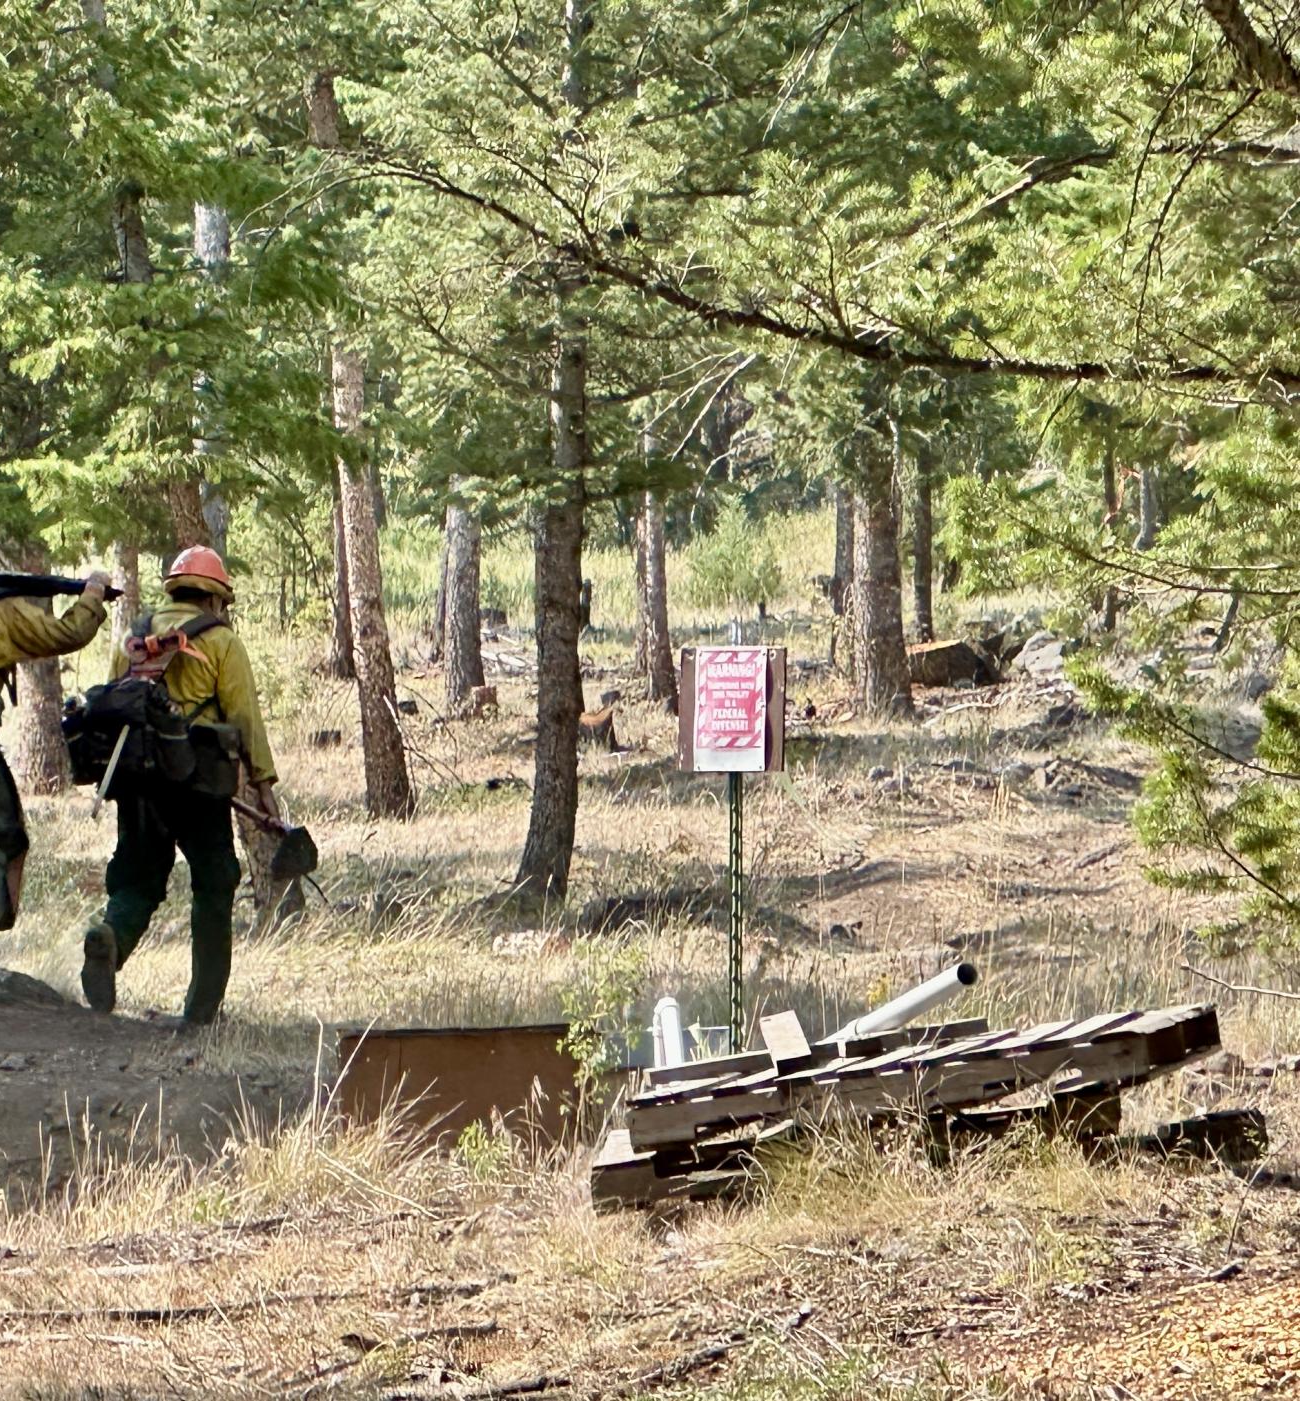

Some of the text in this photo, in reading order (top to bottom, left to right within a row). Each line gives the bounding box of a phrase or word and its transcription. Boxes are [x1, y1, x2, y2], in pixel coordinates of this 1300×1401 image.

[707, 663, 755, 677] WARNING!
[731, 699, 736, 707] A
[713, 708, 748, 719] FEDERAL
